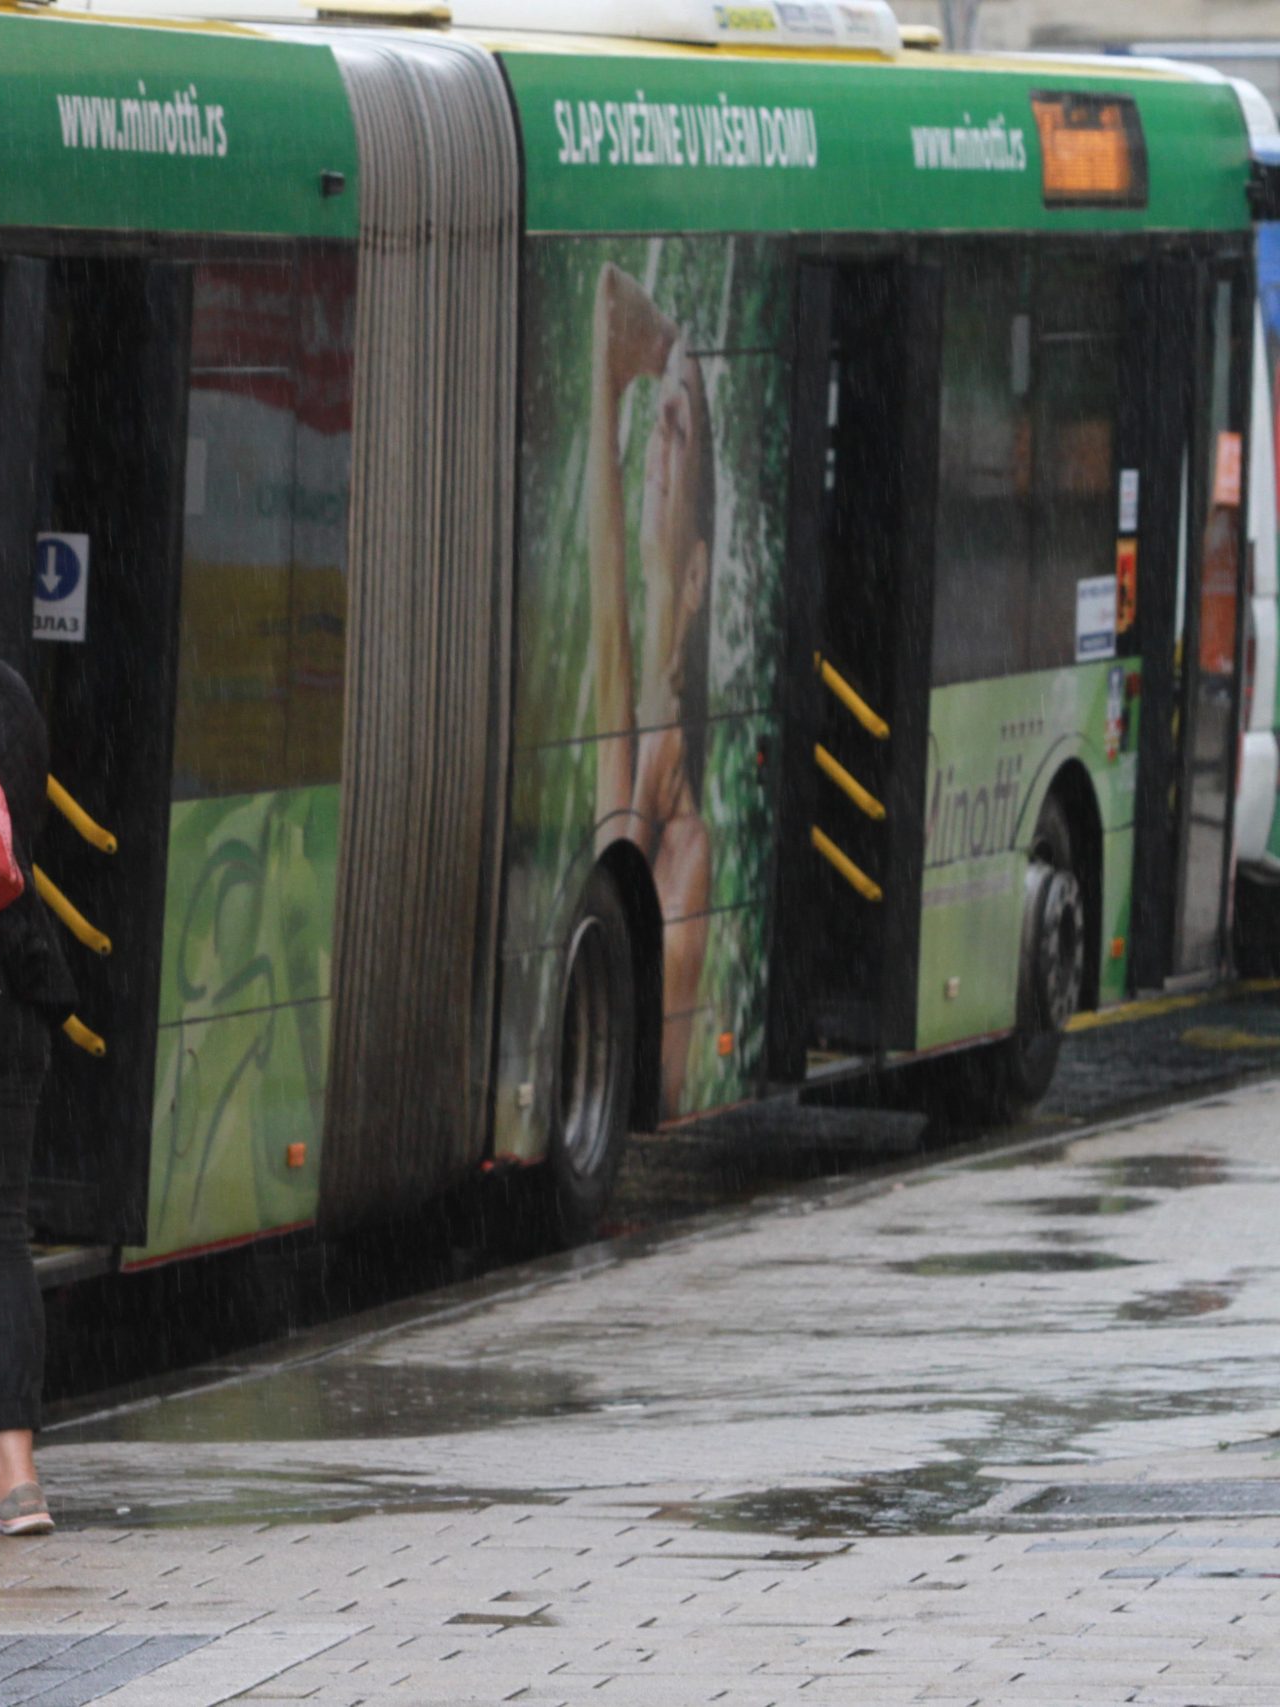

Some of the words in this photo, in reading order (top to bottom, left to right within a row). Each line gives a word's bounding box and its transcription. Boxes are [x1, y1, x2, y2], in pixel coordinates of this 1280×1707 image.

[56, 78, 227, 156] www.minotti.rs
[554, 99, 604, 165] SLAP
[604, 89, 684, 166] SVEŽINE
[681, 103, 699, 166] U
[697, 91, 762, 167] VAŠEM
[760, 106, 817, 168] DOMU
